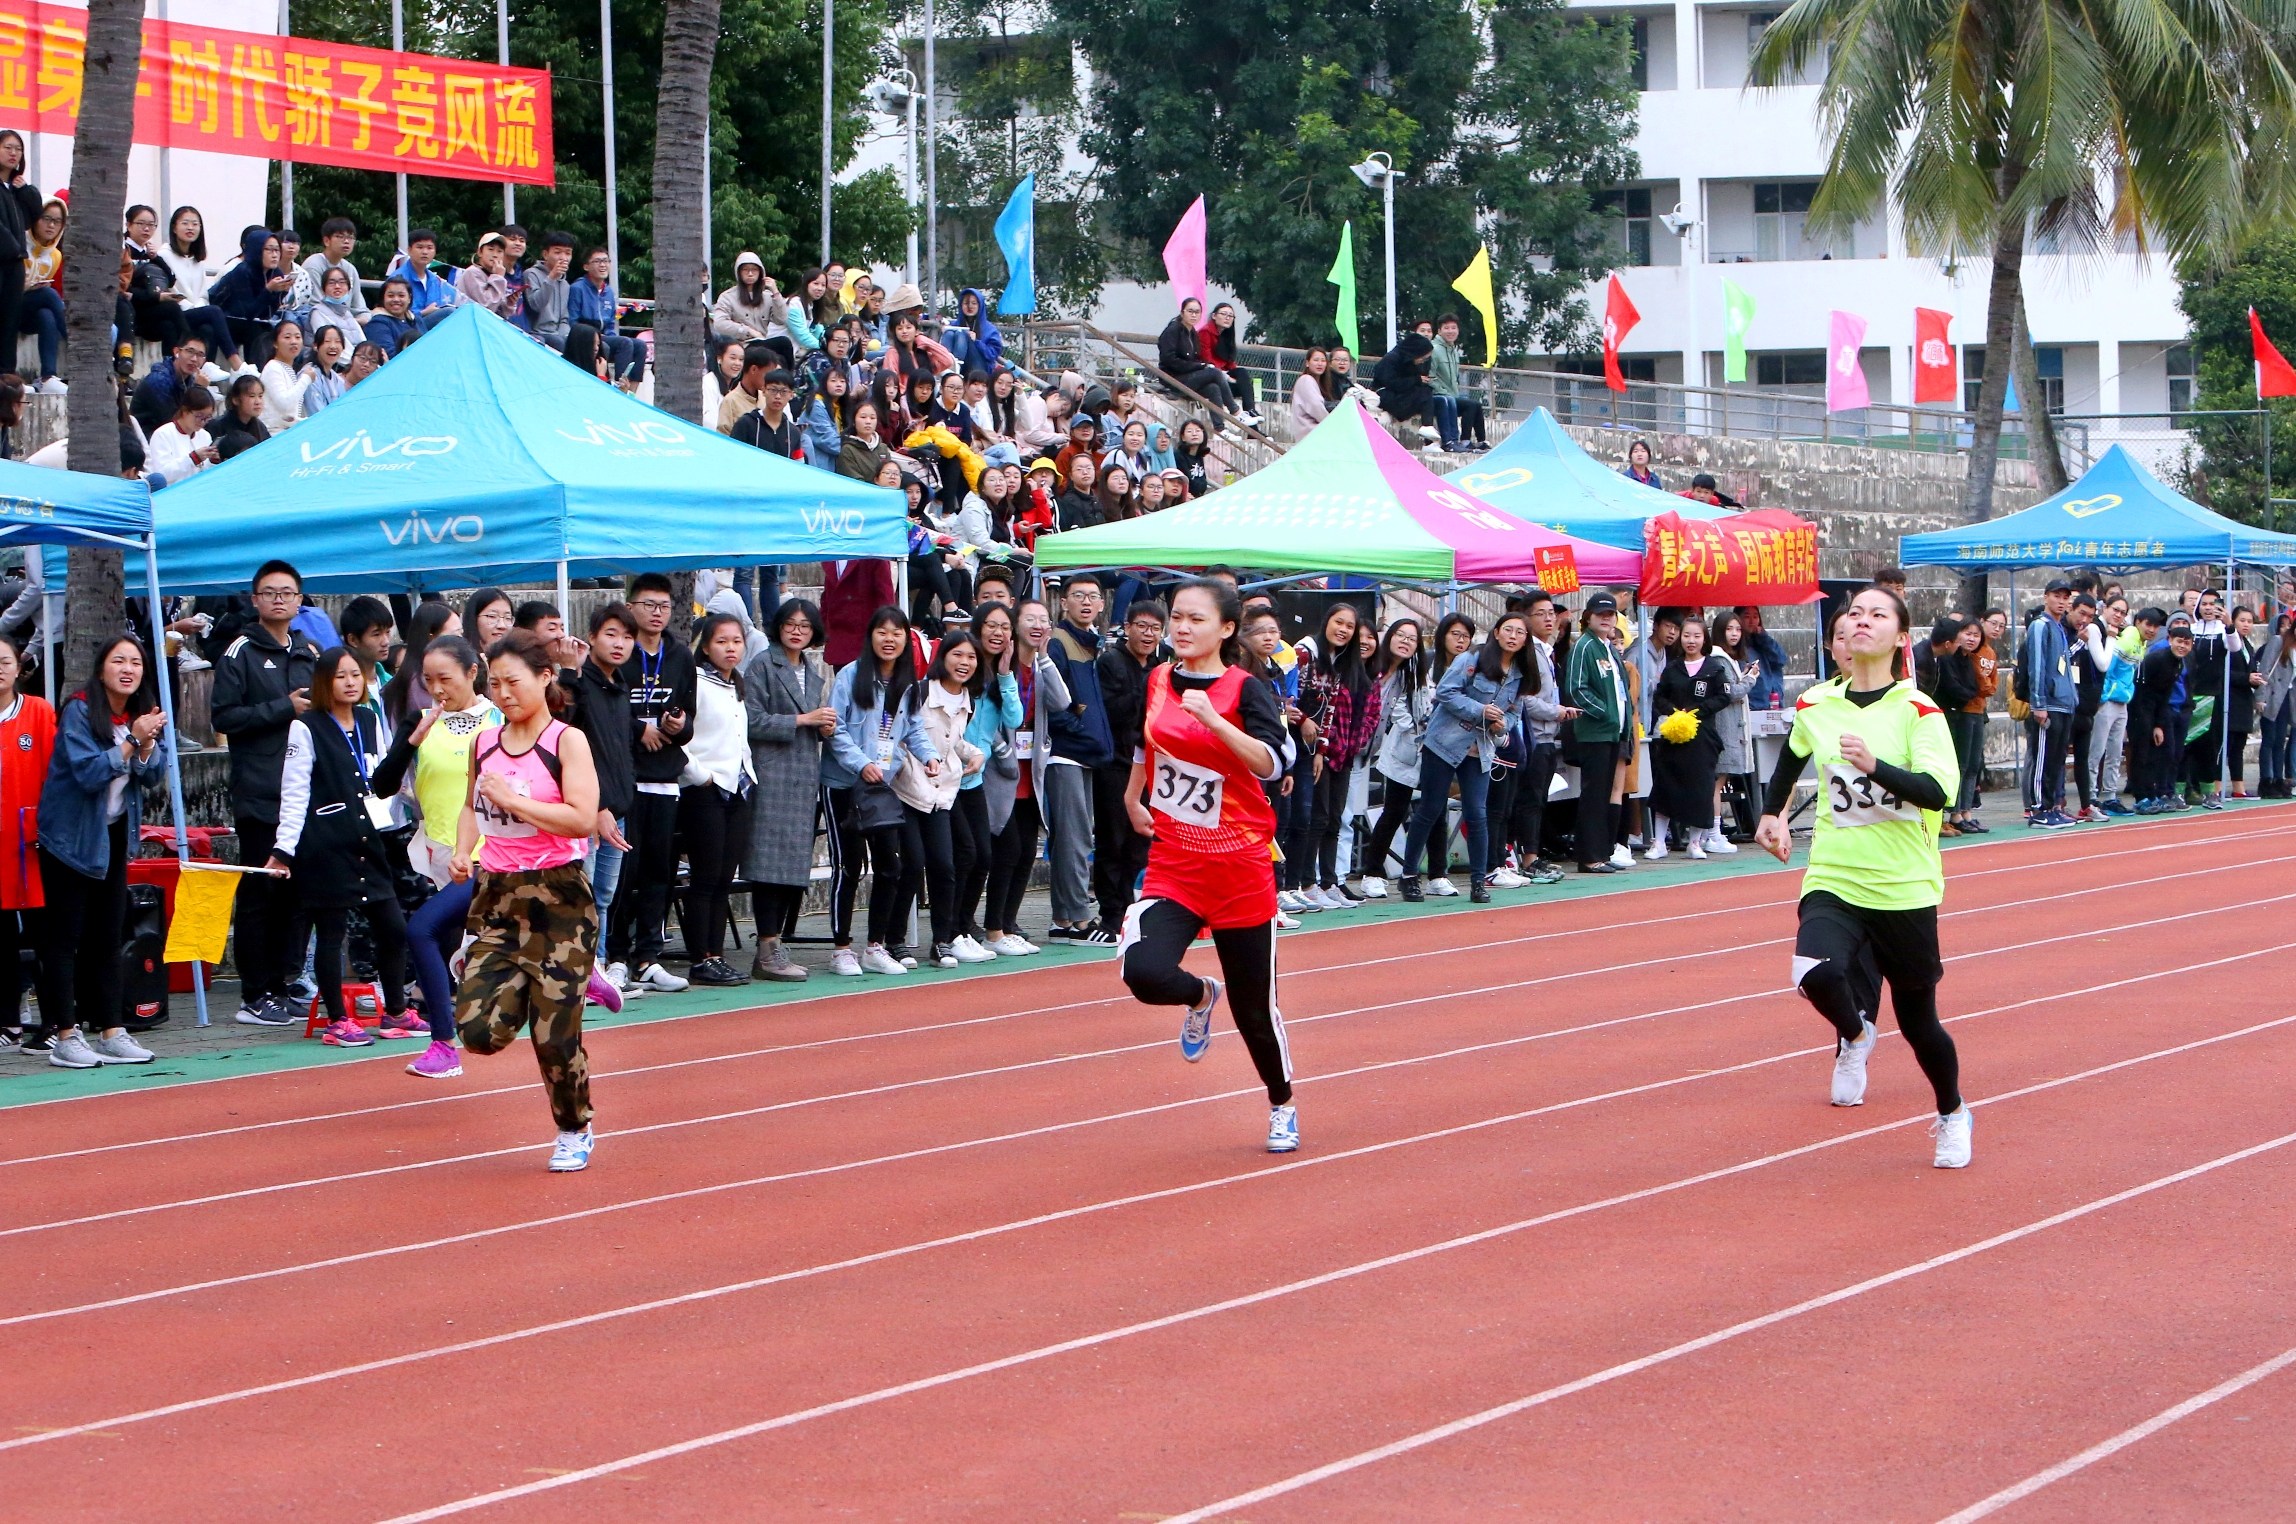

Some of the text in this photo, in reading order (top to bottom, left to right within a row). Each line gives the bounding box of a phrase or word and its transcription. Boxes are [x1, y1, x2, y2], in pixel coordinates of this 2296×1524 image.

[170, 40, 539, 168] 时代骄子竞风流
[301, 429, 458, 463] vivo
[555, 418, 686, 445] vivo
[337, 464, 352, 475] &
[356, 461, 416, 473] Smart
[379, 510, 484, 545] vivo
[801, 501, 865, 534] vivo
[1158, 764, 1215, 814] 373
